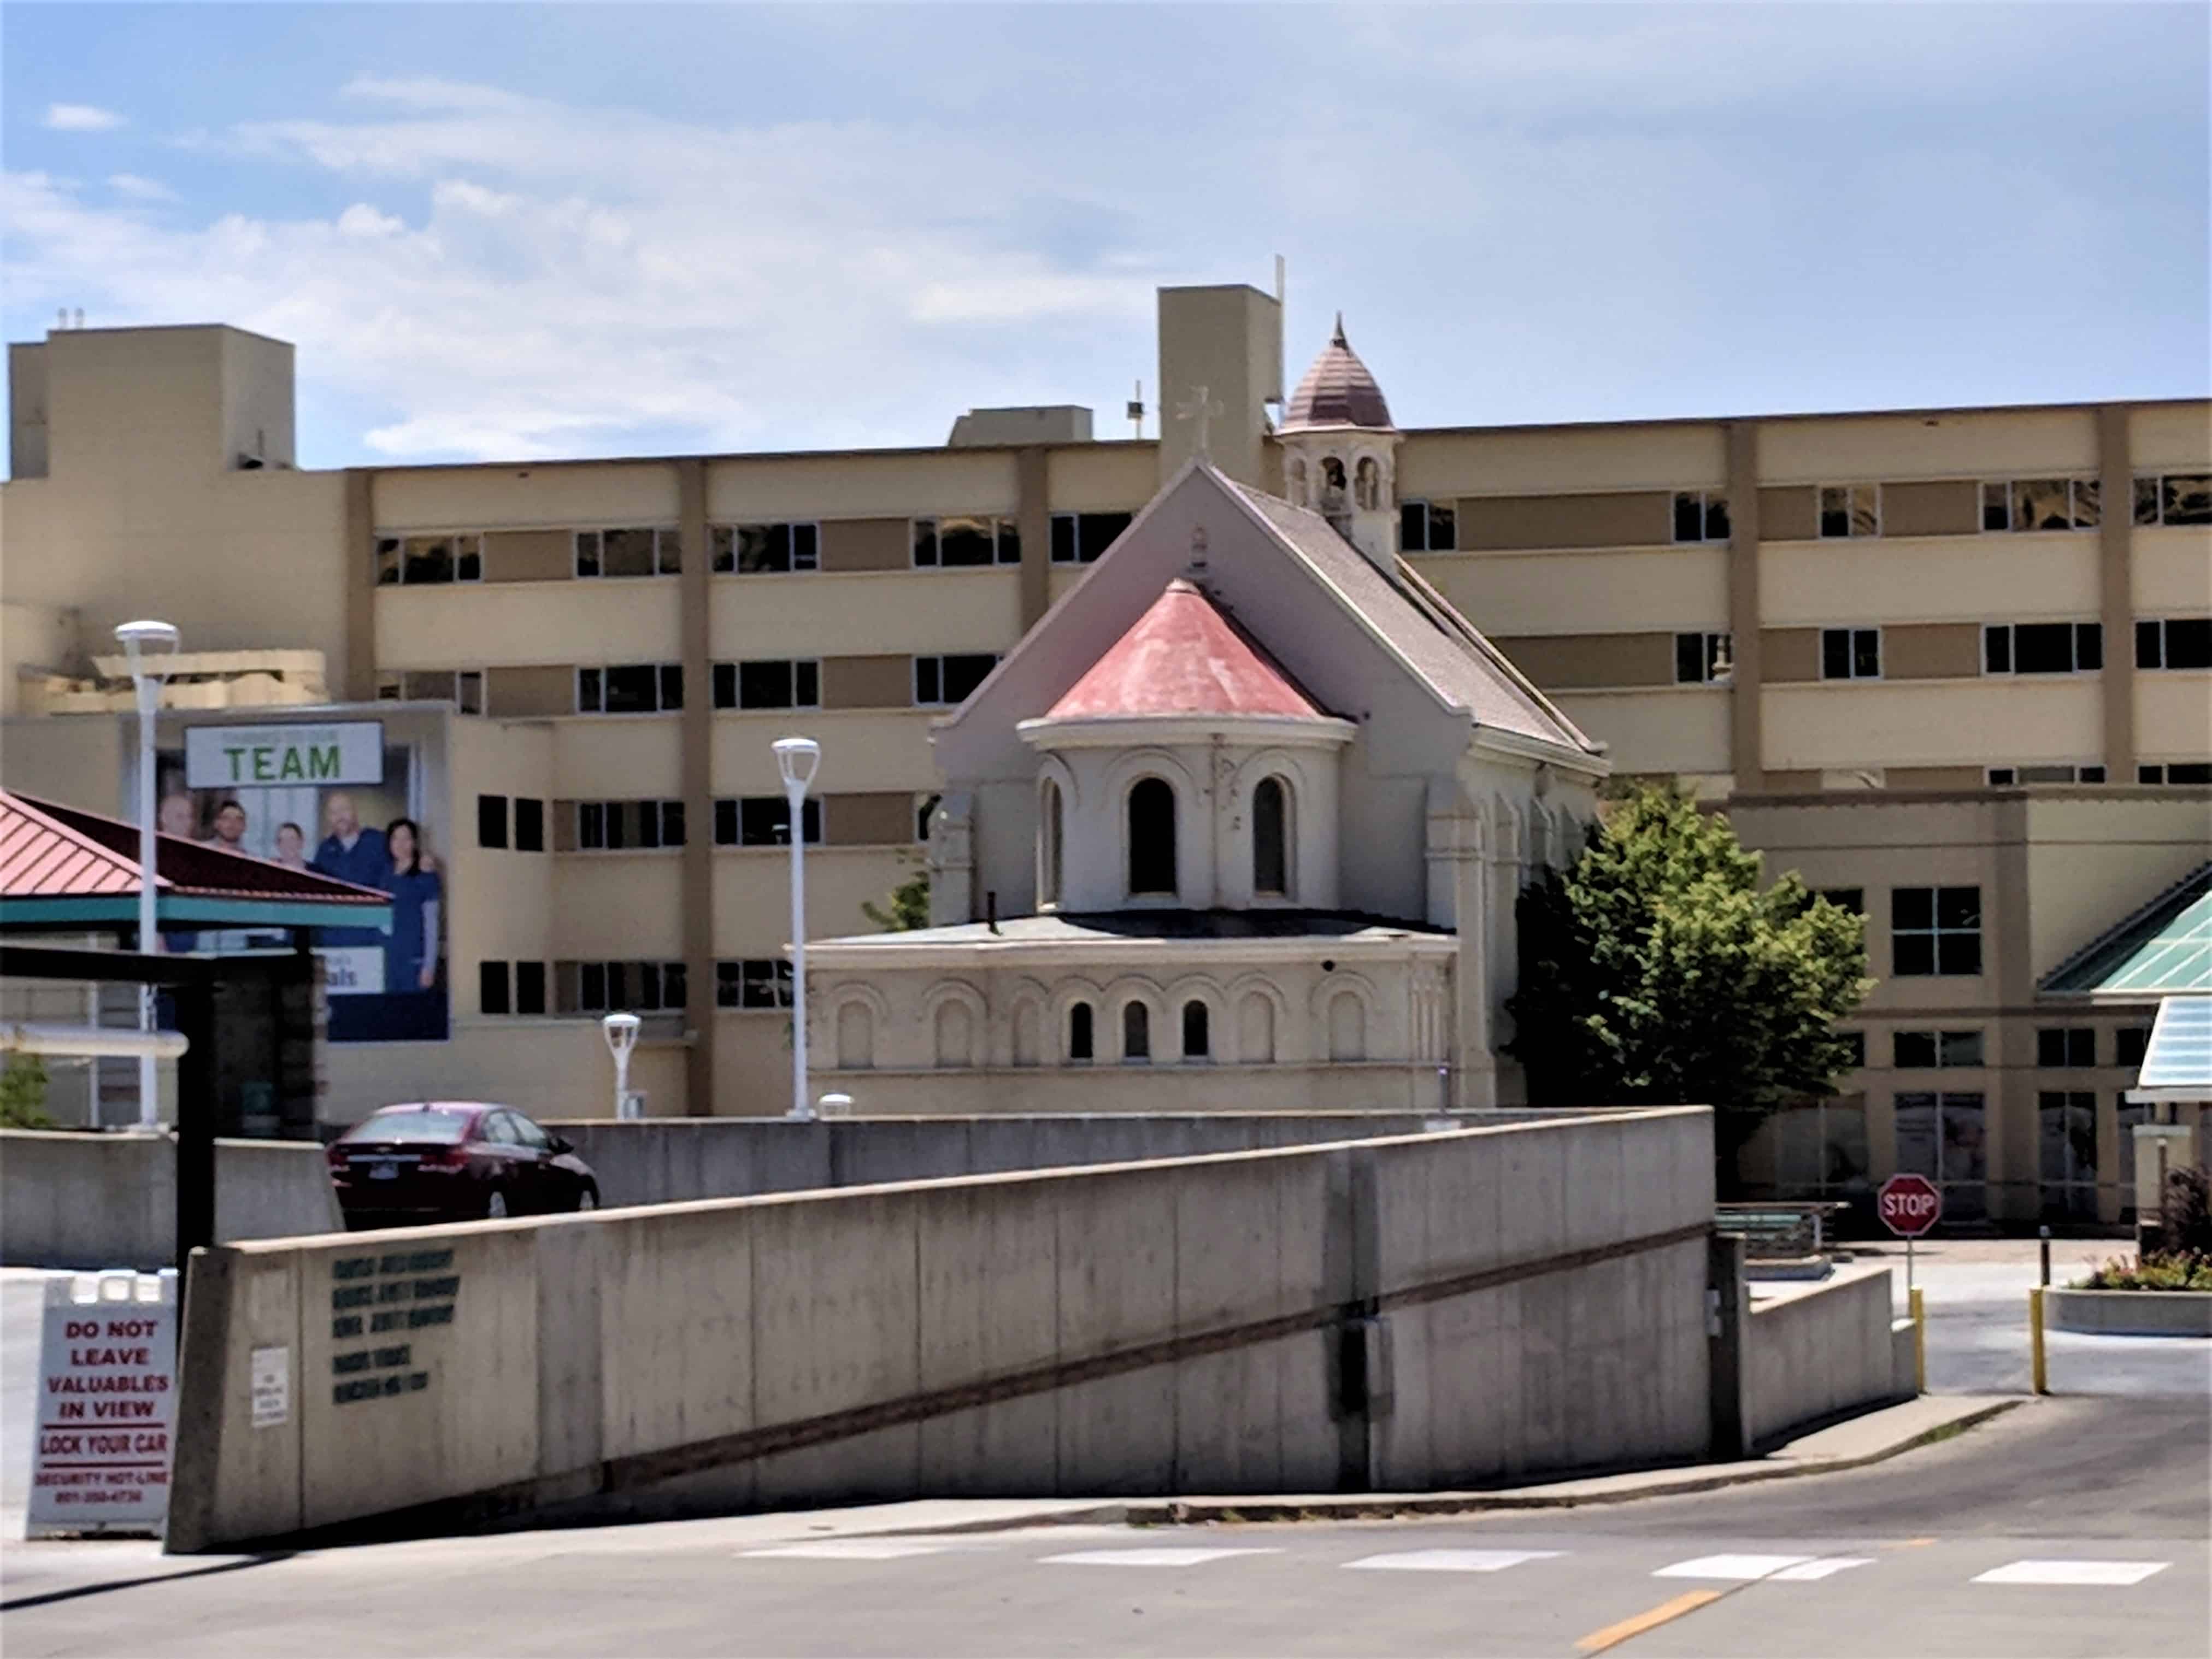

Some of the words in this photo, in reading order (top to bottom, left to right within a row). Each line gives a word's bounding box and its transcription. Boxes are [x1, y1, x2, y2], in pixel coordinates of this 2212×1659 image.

[223, 745, 341, 781] TEAM
[1884, 1193, 1934, 1216] STOP
[66, 1321, 99, 1338] DO
[108, 1320, 158, 1337] NOT
[71, 1348, 149, 1366] LEAVE
[48, 1375, 168, 1393] VALUABLES
[60, 1402, 84, 1418] IN
[93, 1401, 154, 1417] VIEW
[40, 1436, 81, 1455] LOCK
[89, 1434, 130, 1454] YOUR
[135, 1433, 167, 1453] CAR
[36, 1473, 101, 1486] SECURITY
